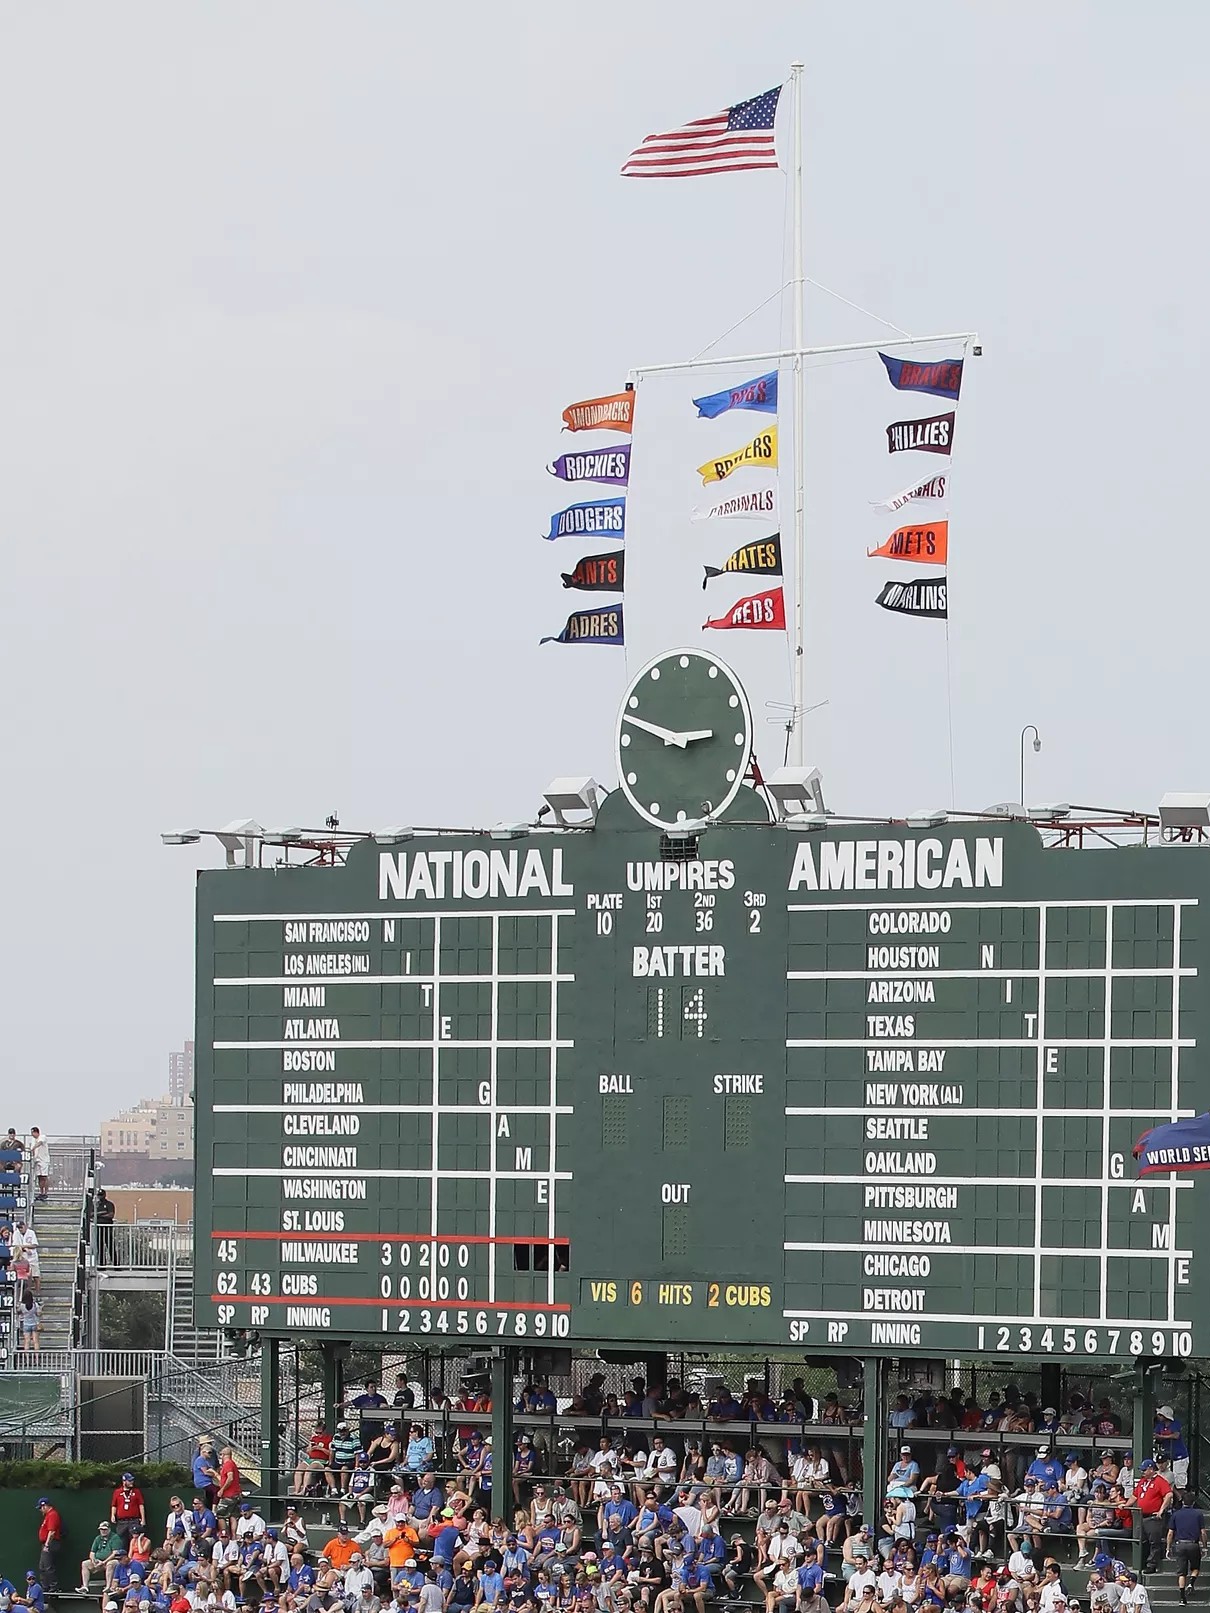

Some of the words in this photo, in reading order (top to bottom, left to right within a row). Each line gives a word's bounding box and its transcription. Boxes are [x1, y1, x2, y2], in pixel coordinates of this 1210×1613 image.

[900, 363, 961, 390] BRAVES
[565, 453, 625, 479] ROCKIES
[558, 506, 622, 534] DODGERS
[890, 531, 935, 555] METS
[722, 543, 776, 571] RATES
[883, 584, 946, 610] MARLINS
[379, 848, 574, 899] NATIONAL
[788, 838, 1003, 890] AMERICAN
[627, 860, 735, 891] UMPIRES
[587, 893, 622, 910] PLATE
[694, 891, 715, 908] 2ND
[744, 890, 766, 907] 3RD
[285, 922, 306, 942] SAN
[309, 921, 370, 942] FRANCISCO
[597, 911, 613, 935] 10
[646, 911, 663, 933] 20
[696, 910, 712, 931] 36
[750, 910, 760, 932] 2
[869, 911, 951, 934] COLORADO
[284, 954, 304, 975] LOS
[633, 946, 726, 977] BATTER
[868, 946, 940, 969] HOUSTON
[384, 920, 395, 942] N
[422, 985, 433, 1007] T
[442, 1017, 452, 1039] E
[284, 986, 326, 1007] MIAMI
[868, 981, 935, 1003] ARIZONA
[982, 945, 994, 968] N
[1025, 1014, 1037, 1038] T
[1047, 1048, 1058, 1073] E
[284, 1018, 340, 1040] ATLANTA
[867, 1015, 915, 1037] TEXAS
[284, 1050, 336, 1072] BOSTON
[867, 1050, 914, 1072] TAMPA
[917, 1050, 946, 1072] BAY
[284, 1083, 364, 1104] PHILADELPHIA
[599, 1075, 634, 1094] BALL
[714, 1074, 764, 1094] STRIKE
[866, 1084, 899, 1105] NEW
[284, 1115, 360, 1135] CLEVELAND
[866, 1118, 928, 1140] SEATTLE
[479, 1082, 490, 1105] G
[498, 1115, 511, 1138] A
[516, 1147, 532, 1171] M
[537, 1181, 548, 1204] E
[20, 1151, 31, 1160] 18
[284, 1147, 357, 1167] CINCINNATI
[865, 1152, 937, 1174] OAKLAND
[1147, 1147, 1190, 1165] WORLD
[19, 1174, 29, 1184] 17
[283, 1179, 366, 1200] WASHINGTON
[15, 1197, 26, 1207] 16
[661, 1184, 691, 1203] OUT
[865, 1186, 958, 1209] PITTSBURGH
[283, 1211, 303, 1231] ST.
[304, 1211, 345, 1232] LOUIS
[1111, 1153, 1124, 1178] G
[1132, 1189, 1146, 1213] A
[1152, 1224, 1169, 1248] M
[1178, 1260, 1190, 1284] E
[864, 1220, 952, 1243] MINNESOTA
[217, 1240, 238, 1262] 45
[281, 1242, 359, 1264] MILWAUKEE
[382, 1243, 392, 1266] 3
[400, 1244, 410, 1266] 0
[420, 1244, 430, 1267] 2
[439, 1245, 449, 1267] 0
[458, 1245, 468, 1267] 0
[6, 1271, 16, 1281] 13
[864, 1254, 931, 1277] CHICAGO
[217, 1272, 237, 1295] 62
[251, 1273, 271, 1296] 43
[282, 1275, 318, 1295] CUBS
[381, 1276, 391, 1298] 0
[400, 1276, 410, 1299] 0
[419, 1277, 429, 1299] 0
[439, 1277, 449, 1300] 0
[458, 1277, 468, 1300] 0
[591, 1282, 617, 1302] VIS
[631, 1281, 642, 1305] 6
[658, 1285, 692, 1305] HITS
[708, 1283, 719, 1307] 2
[725, 1286, 771, 1306] CUBS
[3, 1296, 13, 1306] 12
[863, 1289, 926, 1311] DETROIT
[1, 1322, 10, 1333] 11
[217, 1305, 236, 1325] SP
[251, 1306, 270, 1326] RP
[286, 1307, 331, 1327] INNING
[382, 1309, 388, 1332] 1
[399, 1309, 410, 1332] 2
[420, 1310, 431, 1332] 3
[437, 1311, 448, 1333] 4
[457, 1311, 468, 1333] 5
[475, 1311, 487, 1333] 6
[497, 1312, 508, 1335] 7
[515, 1313, 526, 1336] 8
[535, 1313, 547, 1336] 9
[552, 1313, 569, 1337] 10
[789, 1321, 809, 1341] SP
[828, 1322, 849, 1343] RP
[871, 1323, 921, 1345] INNING
[978, 1327, 985, 1350] 1
[997, 1327, 1010, 1351] 2
[1018, 1328, 1032, 1352] 3
[1040, 1328, 1054, 1352] 4
[1063, 1329, 1076, 1353] 5
[1084, 1329, 1097, 1354] 6
[1107, 1331, 1120, 1355] 7
[1129, 1331, 1143, 1356] 8
[1151, 1332, 1165, 1356] 9
[1172, 1332, 1192, 1357] 10
